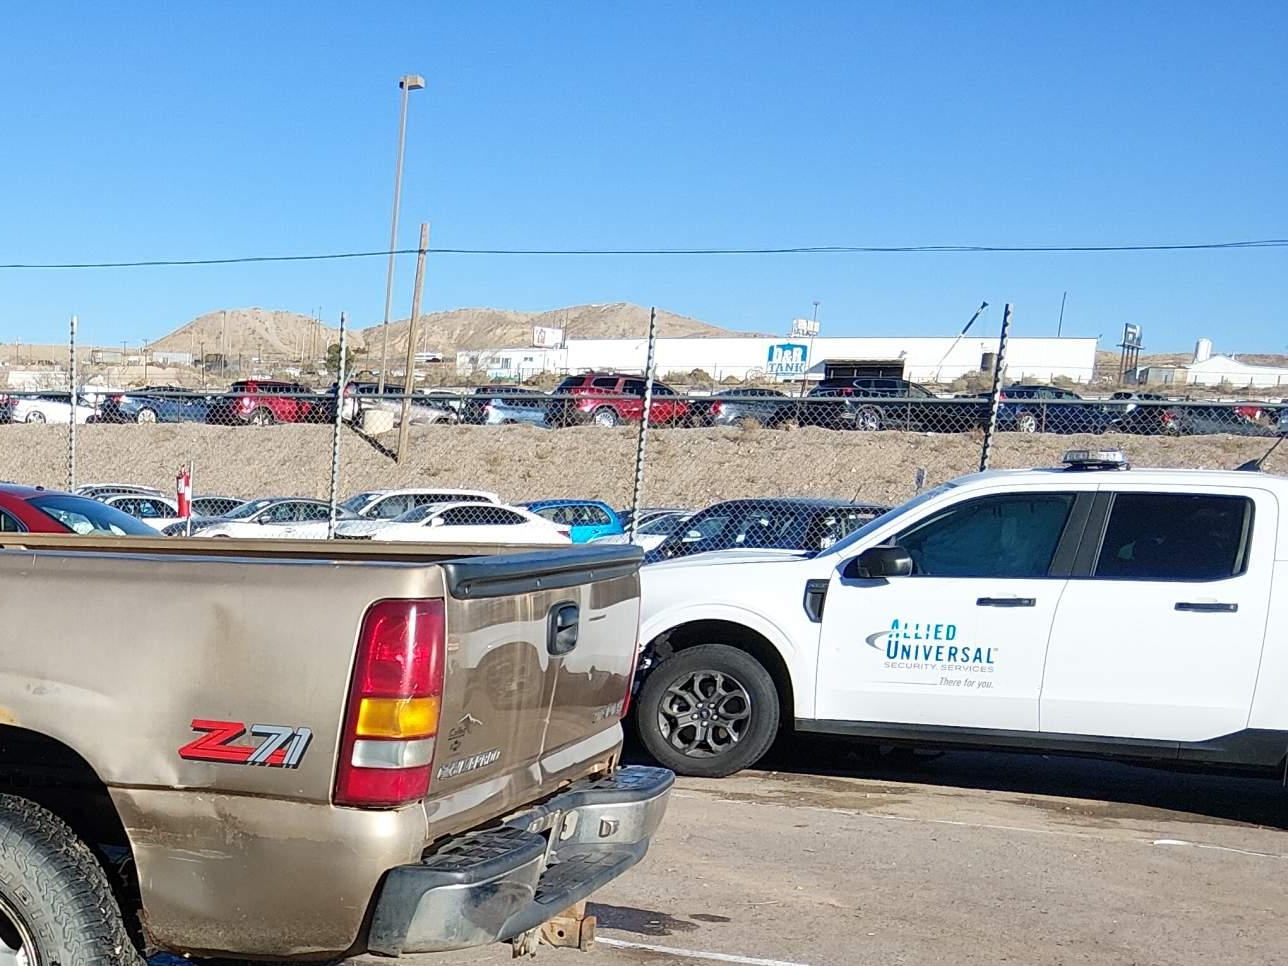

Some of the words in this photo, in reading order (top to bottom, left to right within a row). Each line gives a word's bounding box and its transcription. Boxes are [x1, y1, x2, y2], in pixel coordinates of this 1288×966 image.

[769, 363, 804, 372] TANK
[889, 619, 957, 640] ALLIED
[886, 640, 995, 663] UNIVERSAL
[884, 661, 937, 670] SECURITY
[941, 664, 994, 673] SERVICES
[939, 676, 962, 687] There
[963, 677, 976, 688] for
[977, 679, 994, 689] you.
[178, 719, 313, 769] Z71
